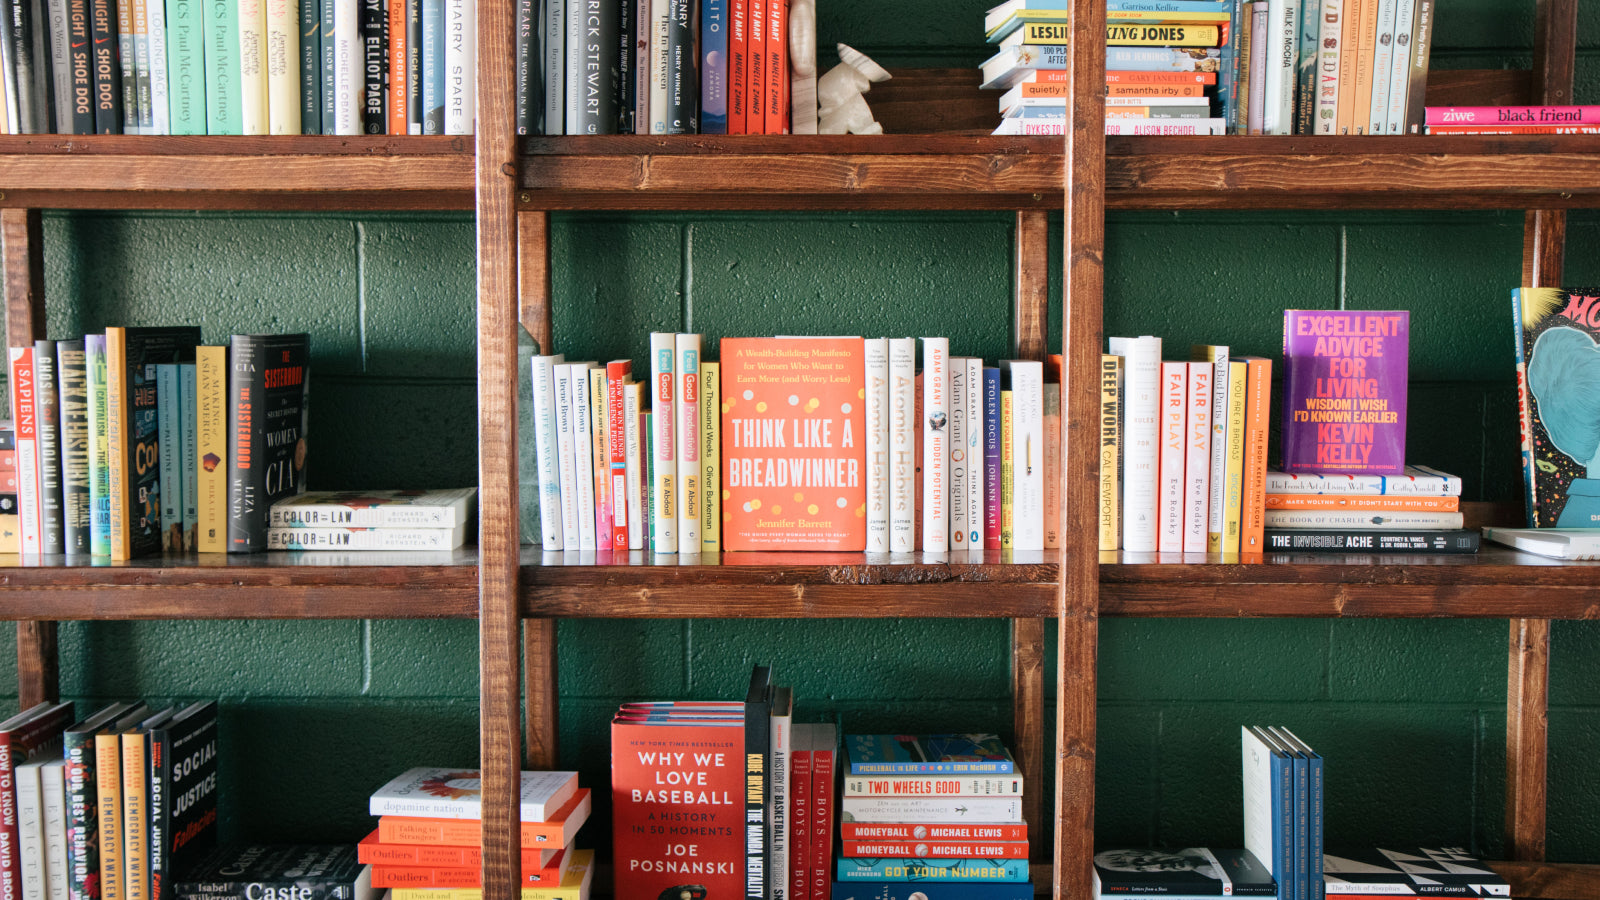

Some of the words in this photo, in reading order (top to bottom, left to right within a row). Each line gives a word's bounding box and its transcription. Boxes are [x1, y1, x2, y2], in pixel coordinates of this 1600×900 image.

[1122, 2, 1154, 11] Garrison
[1156, 3, 1180, 12] Keillor
[1284, 8, 1294, 28] MILK
[136, 0, 144, 39] GENDER
[453, 0, 462, 52] HARRY
[772, 20, 780, 41] MART
[216, 25, 228, 51] Paul
[396, 38, 403, 48] IN
[1141, 28, 1185, 40] JONES
[368, 37, 380, 79] ELLIOT
[520, 43, 528, 57] THE
[1283, 38, 1292, 67] MOCHA
[74, 53, 86, 84] SHOE
[98, 49, 110, 80] SHOE
[772, 53, 780, 86] MICHELLE
[216, 55, 228, 122] McCartney
[327, 75, 333, 87] MY
[520, 61, 528, 93] WOMAN
[588, 44, 600, 115] STEWART
[76, 88, 89, 114] DOG
[100, 84, 112, 110] DOG
[368, 84, 380, 114] PAGE
[397, 85, 403, 97] TO
[453, 66, 462, 117] SPARE
[520, 97, 528, 105] IN
[772, 89, 780, 115] ZAUNER
[1030, 86, 1060, 97] quietly
[1116, 86, 1159, 95] samantha
[1162, 86, 1178, 97] irby
[1443, 109, 1475, 122] ziwe
[1498, 109, 1535, 121] black
[1540, 109, 1582, 121] friend
[1134, 124, 1161, 135] ALISON
[1164, 124, 1196, 135] BECHDEL
[1297, 316, 1400, 336] EXCELLENT
[746, 350, 809, 358] Wealth-Building
[1314, 337, 1383, 357] ADVICE
[202, 356, 210, 391] ASIAN
[686, 352, 695, 371] Feel
[1330, 358, 1366, 377] FOR
[38, 357, 53, 405] GHOSTS
[686, 376, 695, 400] Good
[952, 370, 963, 404] Adam
[1103, 361, 1116, 396] DEEP
[1196, 374, 1206, 407] FAIR
[1317, 378, 1378, 398] LIVING
[19, 370, 33, 434] SAPIENS
[240, 388, 250, 400] THE
[577, 378, 586, 404] Brené
[617, 399, 622, 408] TO
[1306, 399, 1351, 410] WISDOM
[1354, 399, 1357, 410] I
[1360, 399, 1388, 410] WISH
[202, 394, 210, 447] AMERICA
[578, 406, 586, 433] Brown
[954, 410, 963, 442] Grant
[1103, 402, 1116, 446] WORK
[1295, 411, 1308, 422] I'D
[1311, 411, 1352, 422] KNOWN
[1354, 411, 1397, 423] EARLIER
[238, 404, 251, 469] SISTERHOOD
[685, 406, 695, 459] Productivity
[732, 419, 785, 448] THINK
[794, 419, 832, 448] LIKE
[842, 419, 853, 448] A
[1195, 413, 1206, 450] PLAY
[1318, 424, 1374, 444] KEVIN
[42, 425, 57, 488] HONOLULU
[1102, 451, 1111, 471] CAL
[1318, 444, 1373, 464] KELLY
[688, 479, 696, 488] Ali
[730, 458, 858, 487] BREADWINNER
[232, 480, 242, 520] MUNDY
[244, 486, 254, 513] LIZA
[688, 490, 696, 516] Abdaal
[952, 468, 965, 521] Originals
[1102, 474, 1112, 527] NEWPORT
[284, 511, 318, 523] COLOR
[331, 511, 352, 523] LAW
[756, 520, 794, 528] Jennifer
[798, 520, 832, 528] Barrett
[1193, 500, 1202, 534] Rodsky
[1272, 536, 1290, 547] THE
[1294, 536, 1342, 547] INVISIBLE
[1346, 536, 1373, 547] ACHE
[638, 752, 684, 766] WHY
[694, 753, 725, 767] WE
[748, 754, 763, 772] KOBE
[656, 771, 707, 785] LOVE
[748, 776, 763, 804] BRYANT
[869, 781, 889, 794] TWO
[894, 781, 931, 794] WHEELS
[936, 781, 960, 794] GOOD
[384, 802, 430, 813] dopamine
[434, 804, 464, 813] nation
[632, 790, 733, 805] BASEBALL
[748, 808, 763, 822] THE
[748, 825, 763, 854] MAMBA
[856, 828, 908, 836] MONEYBALL
[931, 828, 970, 837] MICHAEL
[974, 829, 1002, 837] LEWIS
[665, 844, 698, 857] JOE
[387, 872, 428, 882] Outliers
[630, 860, 734, 874] POSNANSKI
[748, 856, 763, 898] MENTALITY
[885, 866, 910, 877] GOT
[914, 867, 946, 877] YOUR
[952, 867, 1005, 878] NUMBER
[246, 882, 312, 900] Caste
